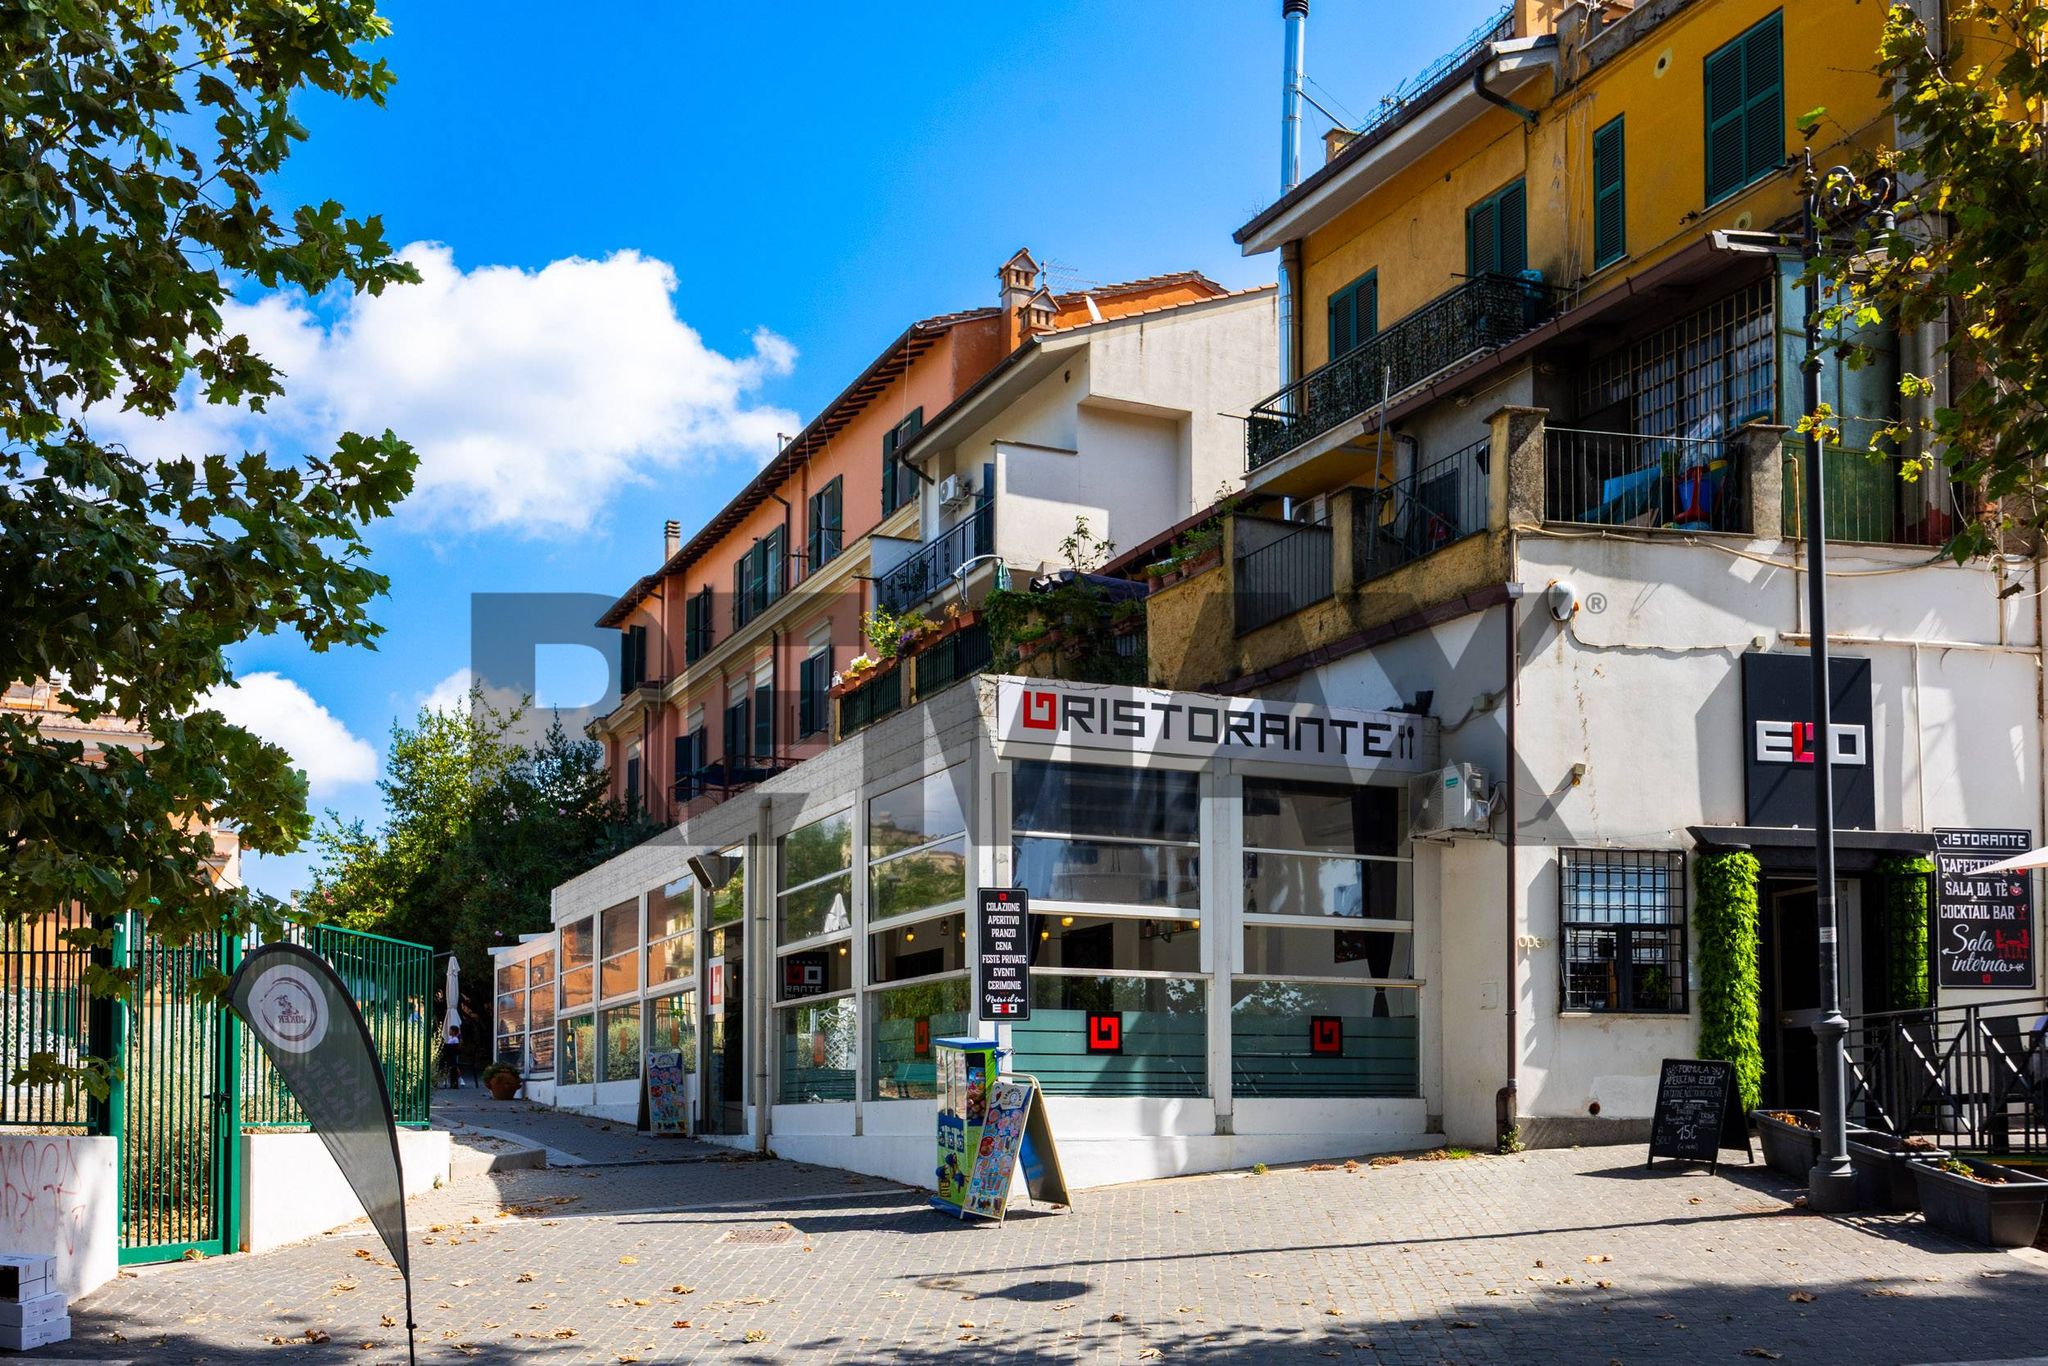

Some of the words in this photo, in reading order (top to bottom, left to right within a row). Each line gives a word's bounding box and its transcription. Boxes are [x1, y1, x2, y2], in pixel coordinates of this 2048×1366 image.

[1062, 694, 1392, 757] RISTORANTE
[1945, 882, 1974, 897] SALA
[1977, 884, 1992, 897] DA
[1994, 879, 2009, 898] TÈ
[986, 903, 1021, 912] COLAZIONE
[1940, 904, 1990, 919] COCKTAIL
[1993, 906, 2016, 920] BAR
[987, 915, 1020, 925] APERITIVO
[991, 928, 1017, 938] PRANZO
[1946, 923, 1995, 955] Sala
[995, 941, 1013, 951] CENA
[982, 954, 1001, 964] FESTE
[1001, 955, 1027, 964] PRIVATE
[1951, 951, 2010, 973] interna
[993, 967, 1016, 977] EVENTI
[987, 981, 1022, 990] CERIMONIE
